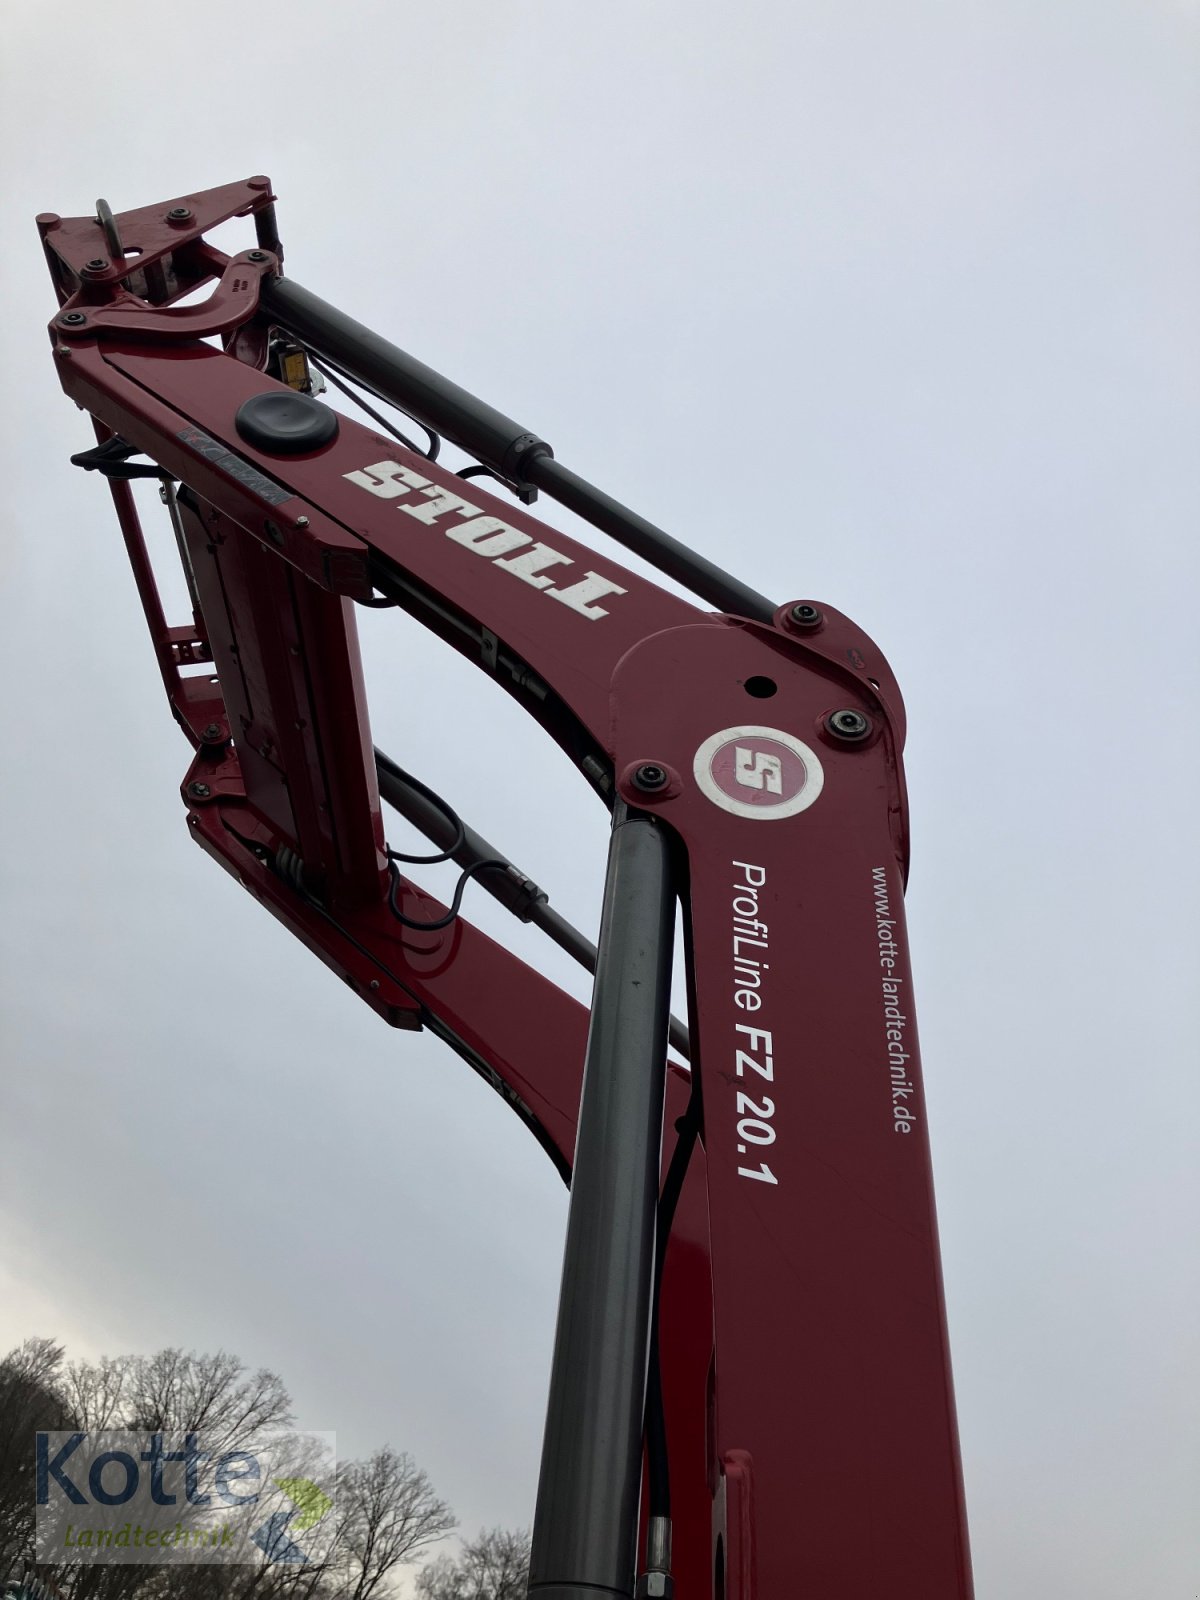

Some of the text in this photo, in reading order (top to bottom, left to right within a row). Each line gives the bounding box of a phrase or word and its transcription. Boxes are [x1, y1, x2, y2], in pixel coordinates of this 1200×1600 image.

[341, 460, 629, 621] STOLL
[732, 860, 779, 1186] ProfiLine FZ 20.1
[871, 866, 917, 1134] www.kotte-landtechnik.de
